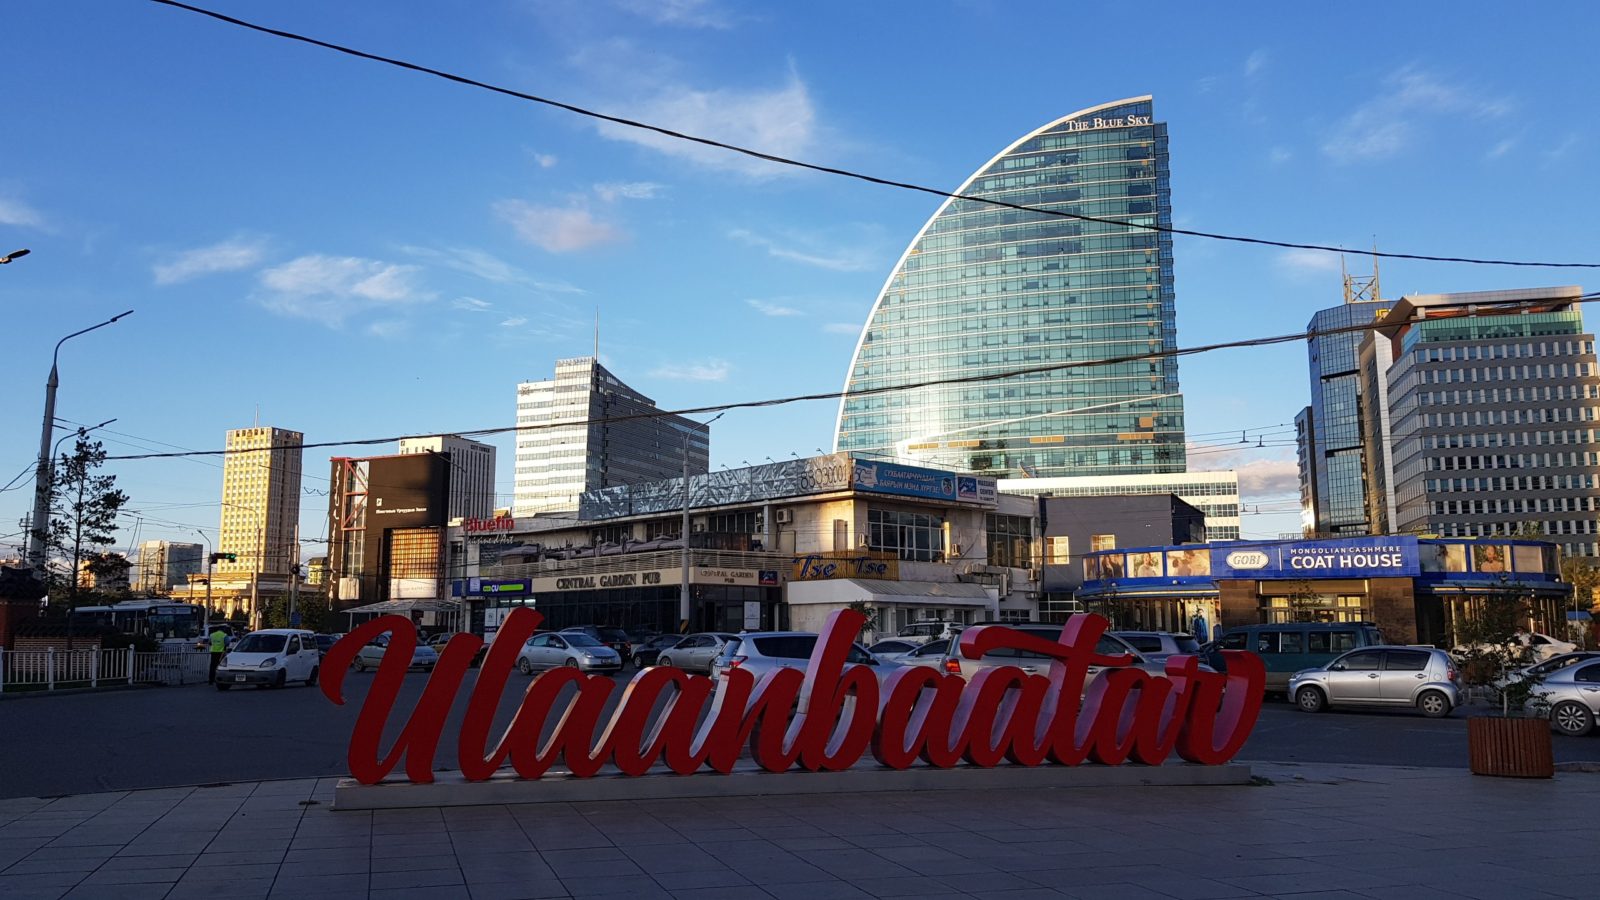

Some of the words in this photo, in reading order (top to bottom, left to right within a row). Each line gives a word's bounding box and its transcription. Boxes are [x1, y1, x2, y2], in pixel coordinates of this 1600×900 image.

[463, 515, 515, 532] Bluefin
[1349, 545, 1401, 553] CASHMERE
[1233, 554, 1261, 565] GOBI
[1291, 555, 1334, 569] COAT
[1340, 553, 1403, 568] HOUSE
[491, 584, 499, 593] CU
[556, 576, 596, 590] CENTRAL
[600, 573, 637, 587] GARDEN
[642, 571, 661, 585] PUB
[319, 607, 1265, 785] Ulaanbaatar
